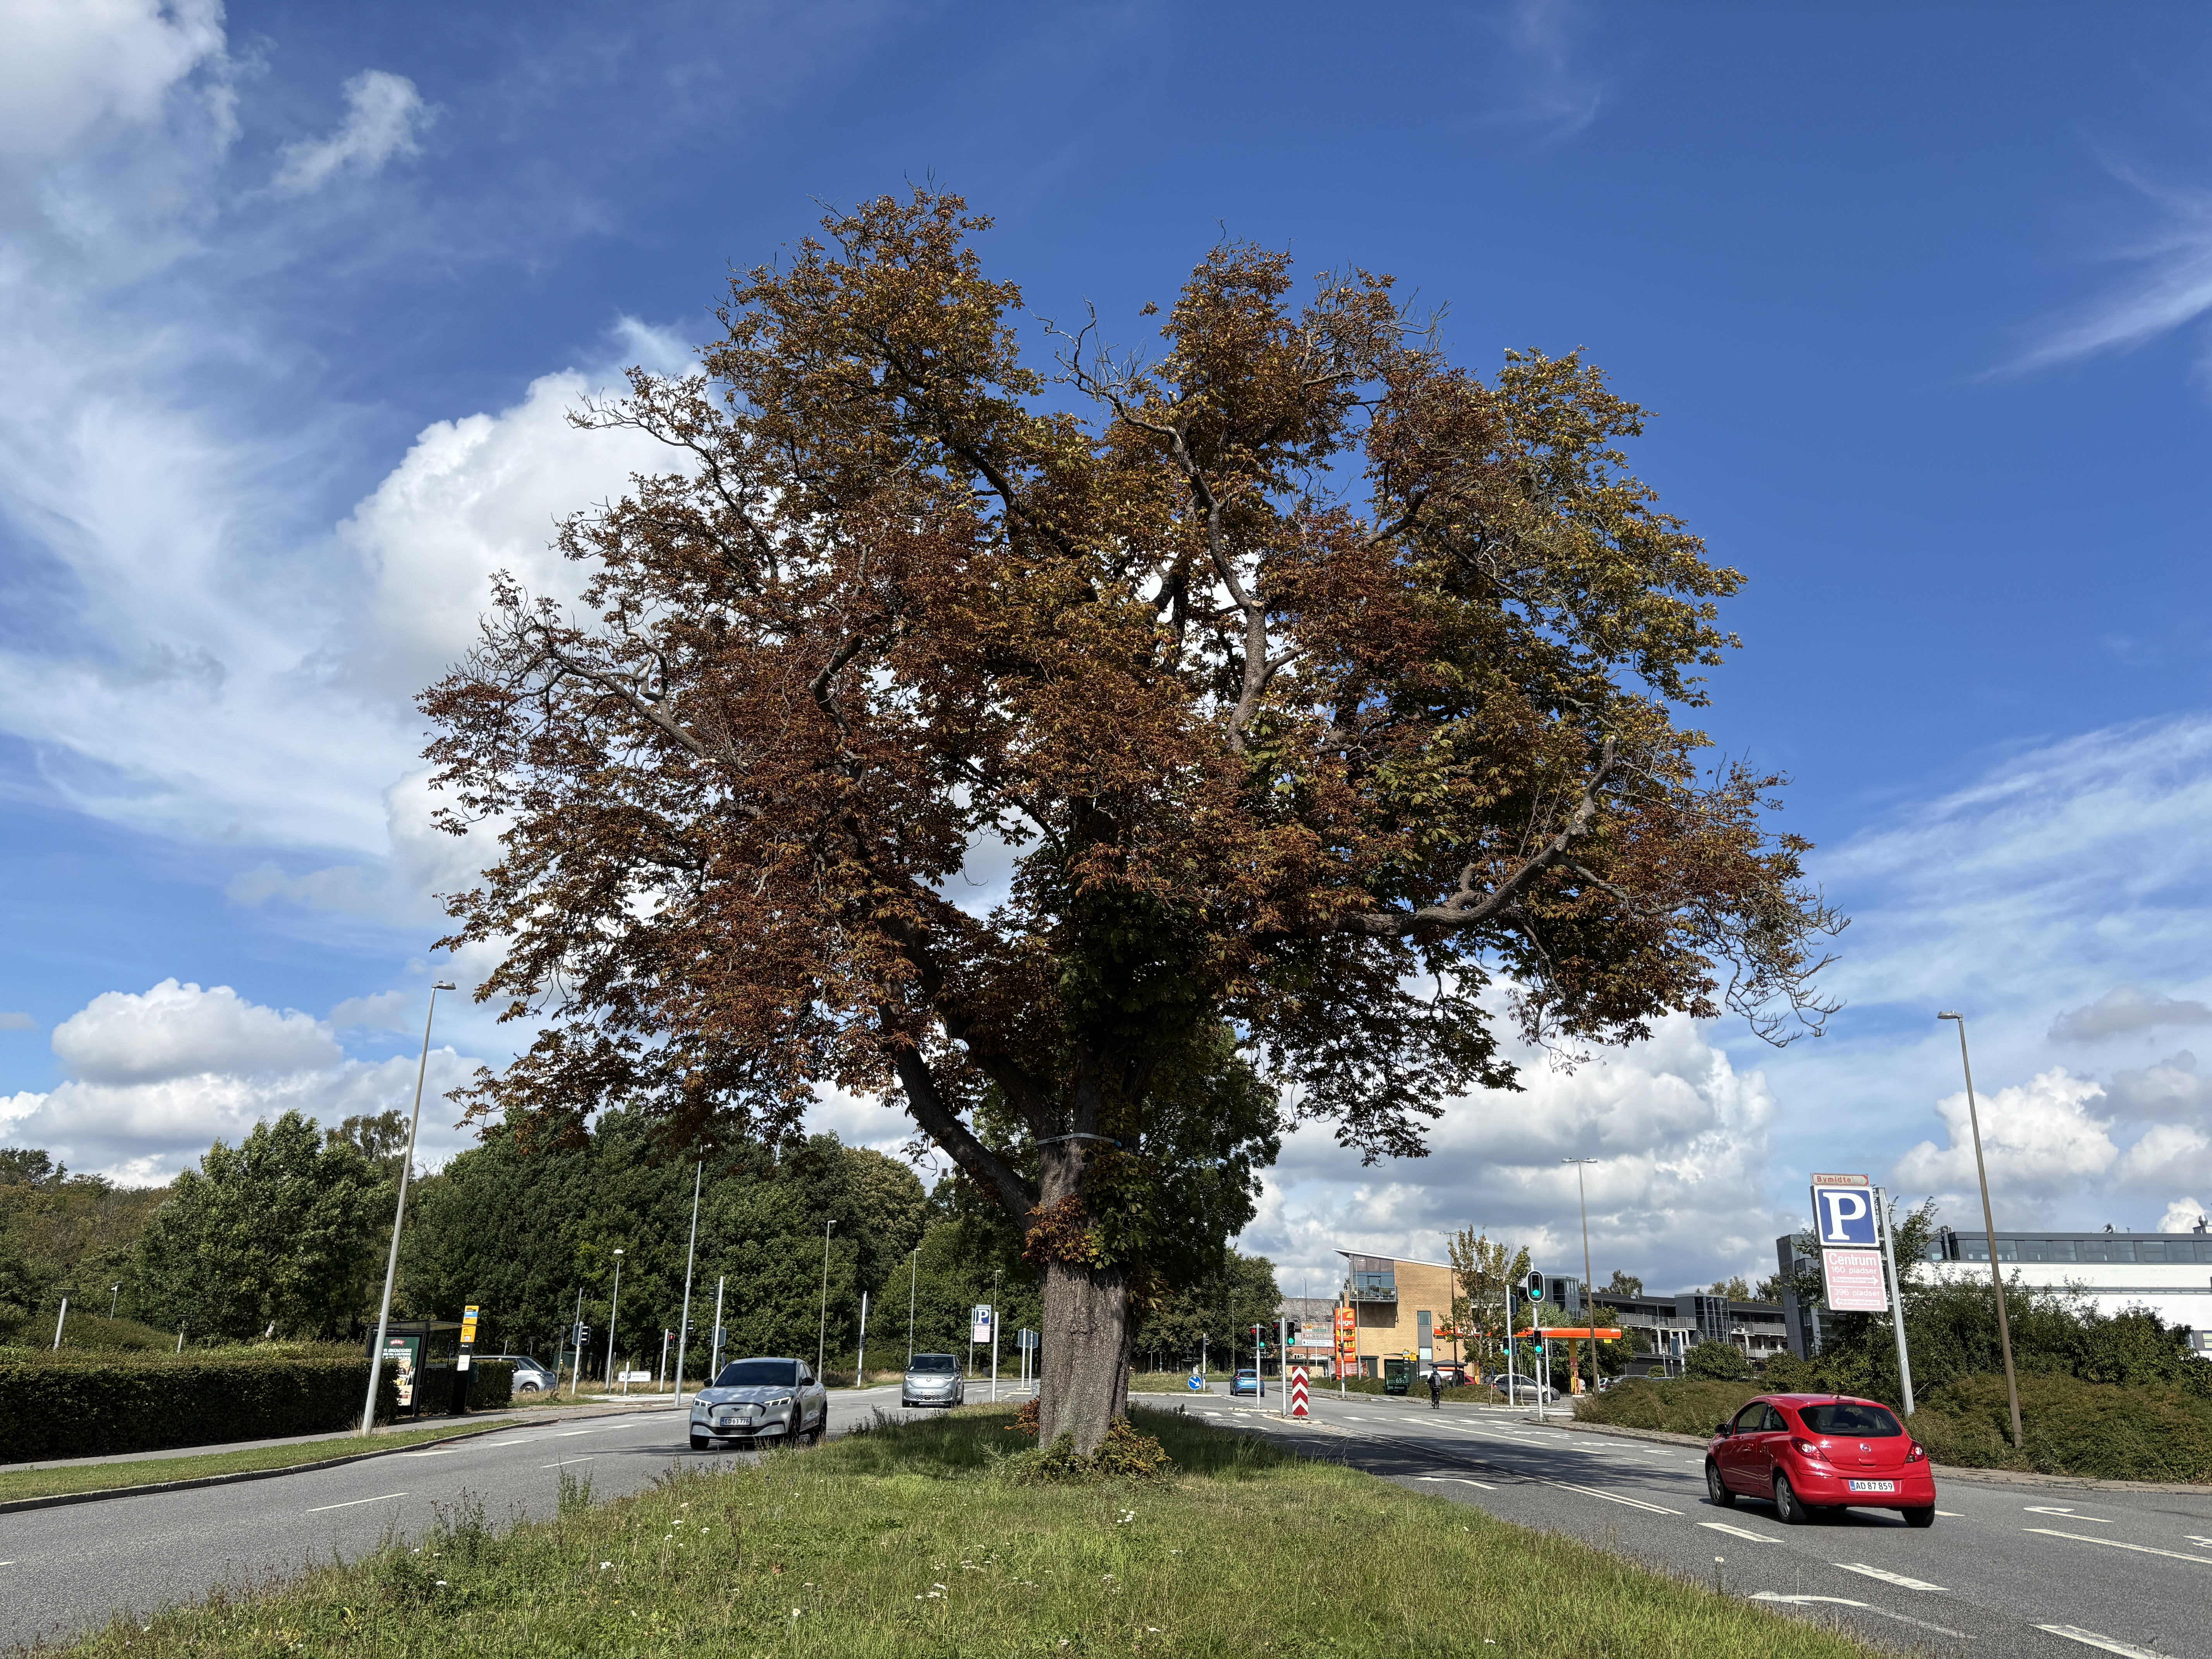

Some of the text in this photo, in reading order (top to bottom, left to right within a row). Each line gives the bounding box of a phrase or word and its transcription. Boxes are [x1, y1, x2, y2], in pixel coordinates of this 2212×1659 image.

[1822, 1192, 1866, 1240] P
[1829, 1253, 1877, 1266] Centrum
[977, 1310, 989, 1323] P
